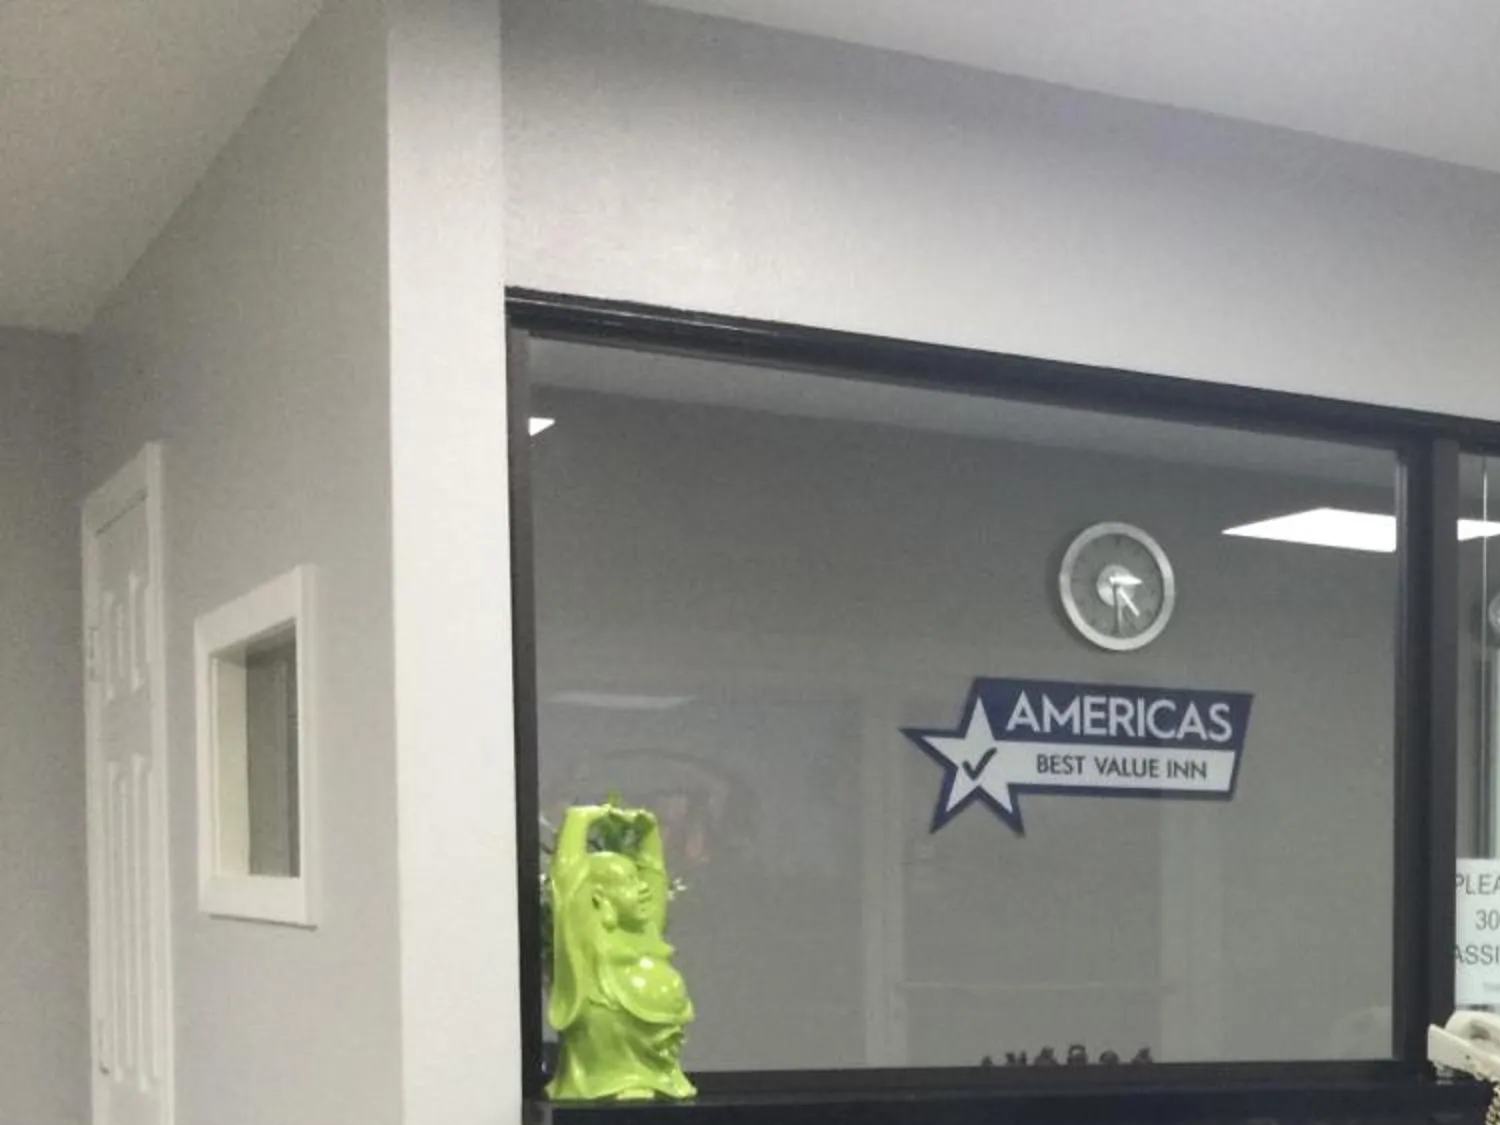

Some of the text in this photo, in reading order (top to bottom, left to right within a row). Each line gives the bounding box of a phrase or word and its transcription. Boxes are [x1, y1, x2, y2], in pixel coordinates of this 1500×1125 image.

[1006, 690, 1233, 742] AMERICAS
[1036, 753, 1207, 779] BEST VALUE INN
